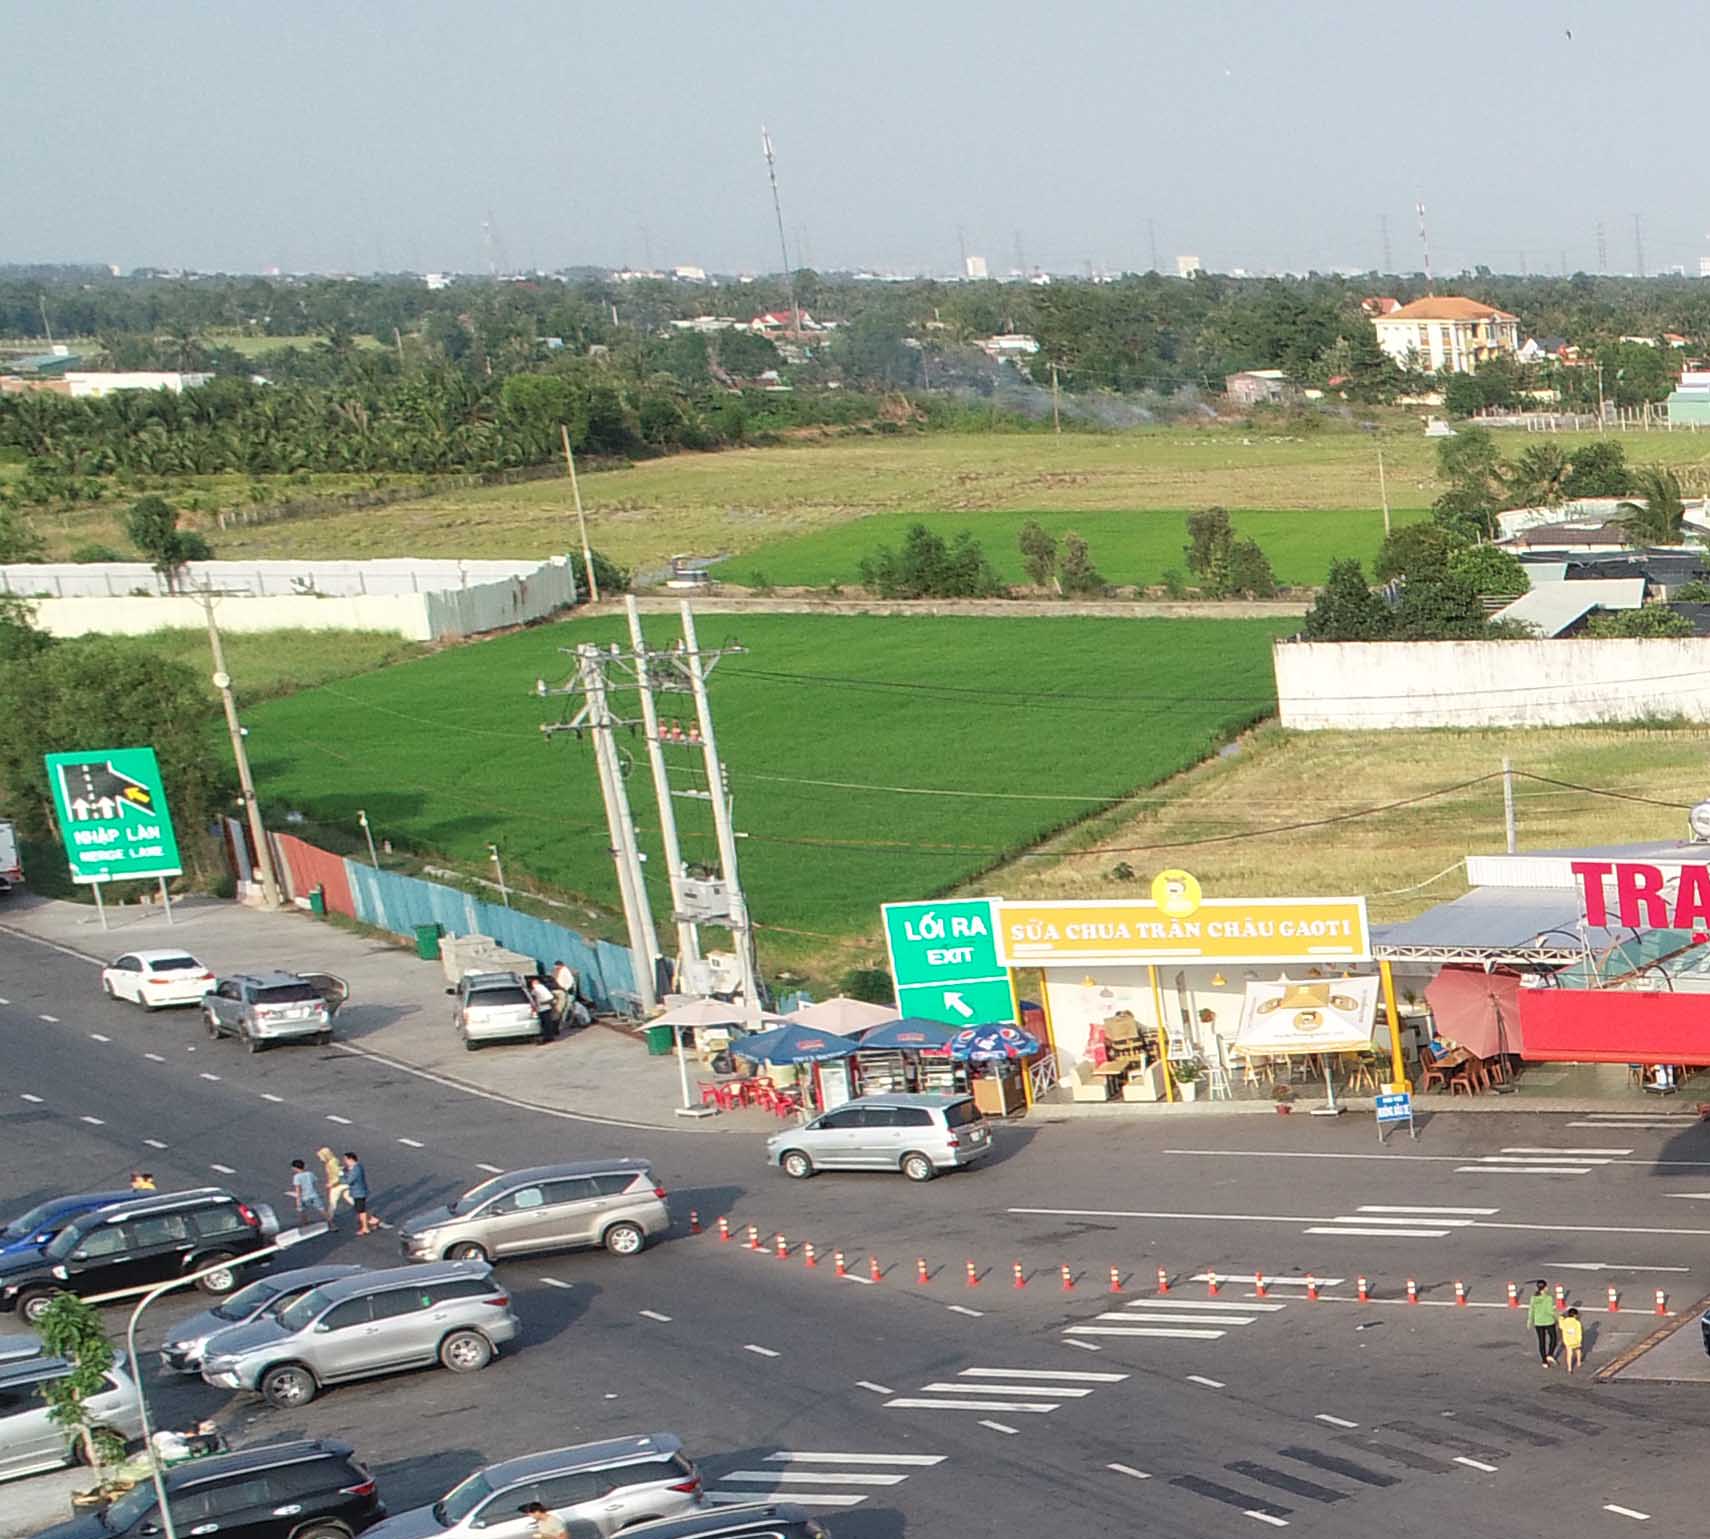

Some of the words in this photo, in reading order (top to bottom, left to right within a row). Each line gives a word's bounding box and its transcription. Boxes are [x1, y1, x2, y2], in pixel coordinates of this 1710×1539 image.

[904, 911, 946, 942] LỐI
[951, 915, 988, 938] RA
[1010, 918, 1061, 941] SỮA
[1065, 922, 1131, 941] CHUA
[1206, 917, 1275, 939] CHÂU
[926, 947, 975, 966] EXIT
